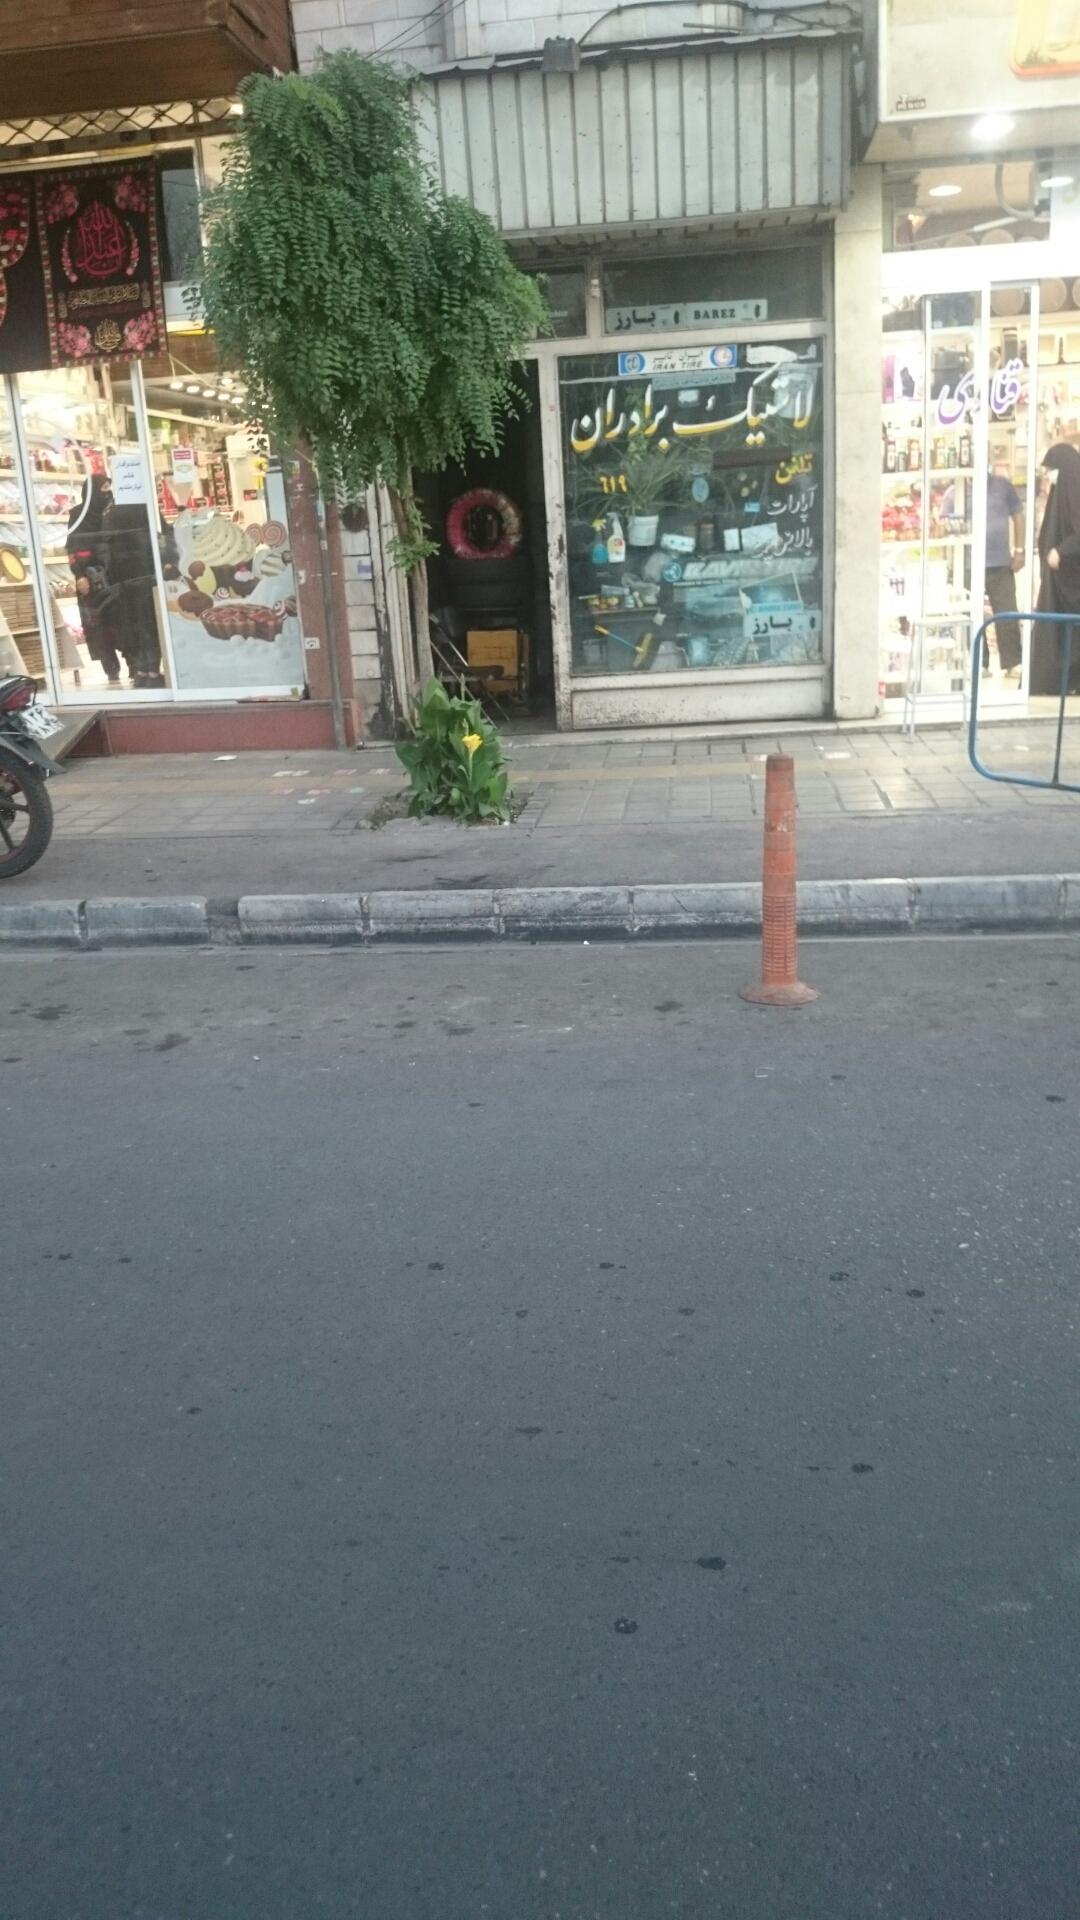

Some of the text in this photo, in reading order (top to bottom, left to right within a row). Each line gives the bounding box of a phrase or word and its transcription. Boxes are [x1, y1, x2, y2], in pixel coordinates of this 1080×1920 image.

[614, 309, 656, 331] بارز
[693, 308, 736, 320] BAREZ
[651, 359, 704, 371] IRAN TIRE
[938, 358, 1023, 425] قنای
[571, 384, 669, 453] برادران
[775, 452, 813, 485] تلفن
[767, 484, 818, 523] آپارات
[752, 615, 792, 635] بارز
